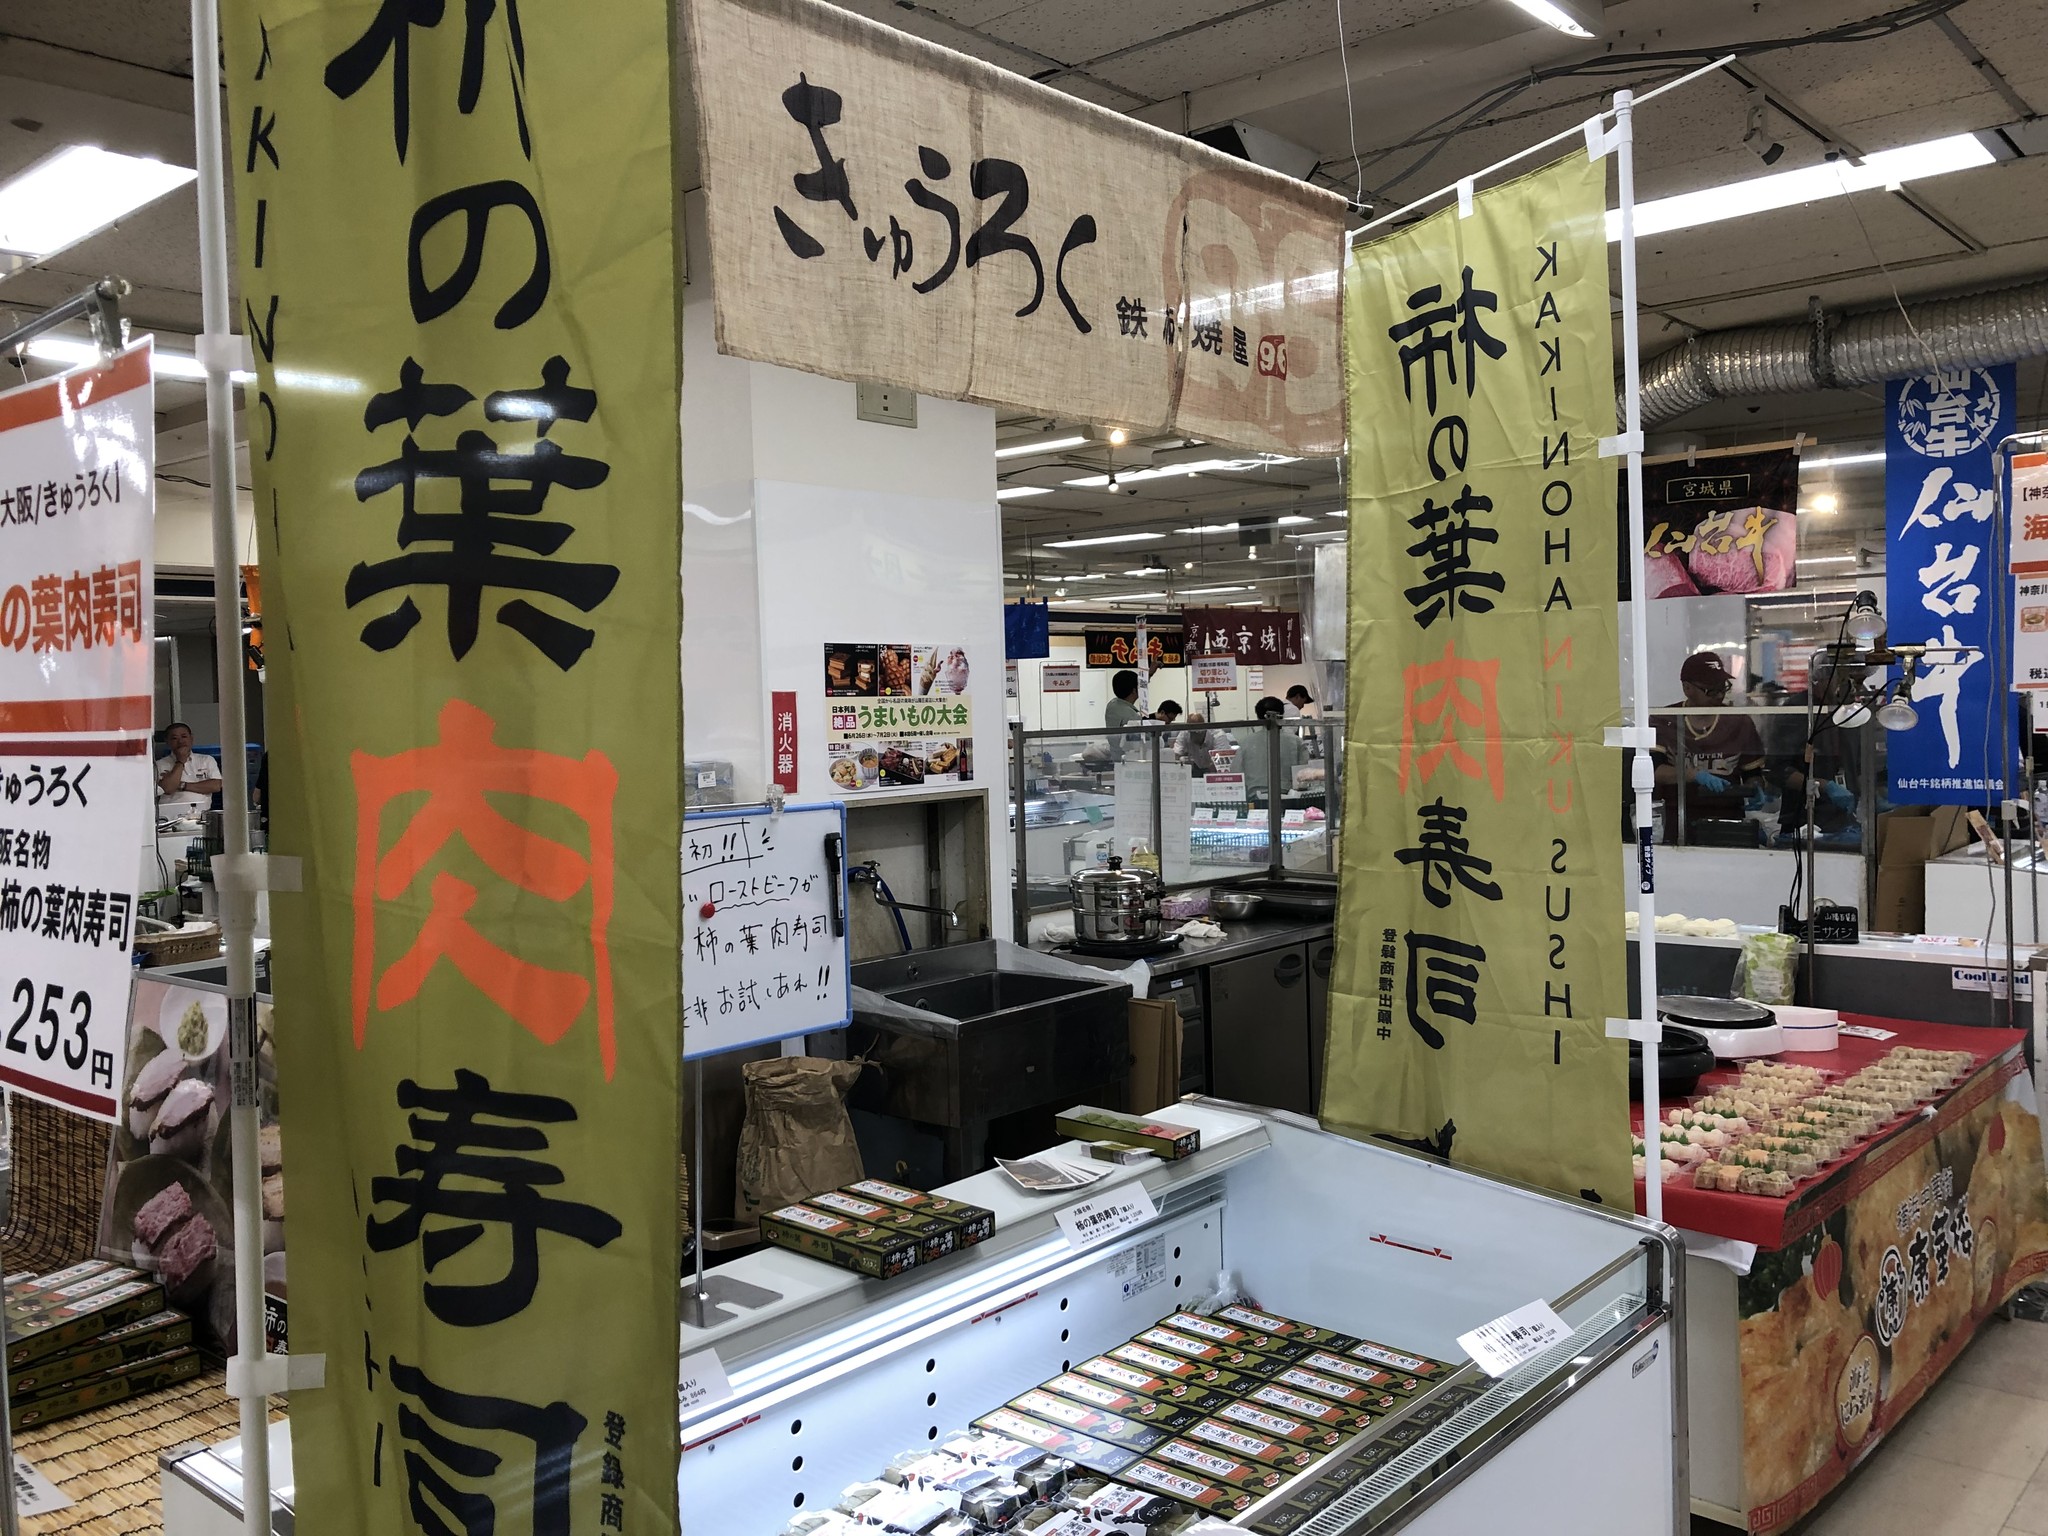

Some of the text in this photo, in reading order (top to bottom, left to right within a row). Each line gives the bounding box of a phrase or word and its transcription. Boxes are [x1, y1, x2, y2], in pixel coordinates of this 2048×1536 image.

[774, 71, 1096, 334] きゅうろく
[1682, 481, 1734, 498] 宮城県
[0, 560, 143, 655] の葉肉寿司
[1212, 625, 1277, 654] 西京焼
[858, 703, 968, 728] うまいもの大会
[777, 711, 794, 775] 消火器
[0, 762, 92, 808] ゅうろく
[1954, 970, 1988, 982] Cool
[1075, 1206, 1120, 1232] 柿の葉肉寿司
